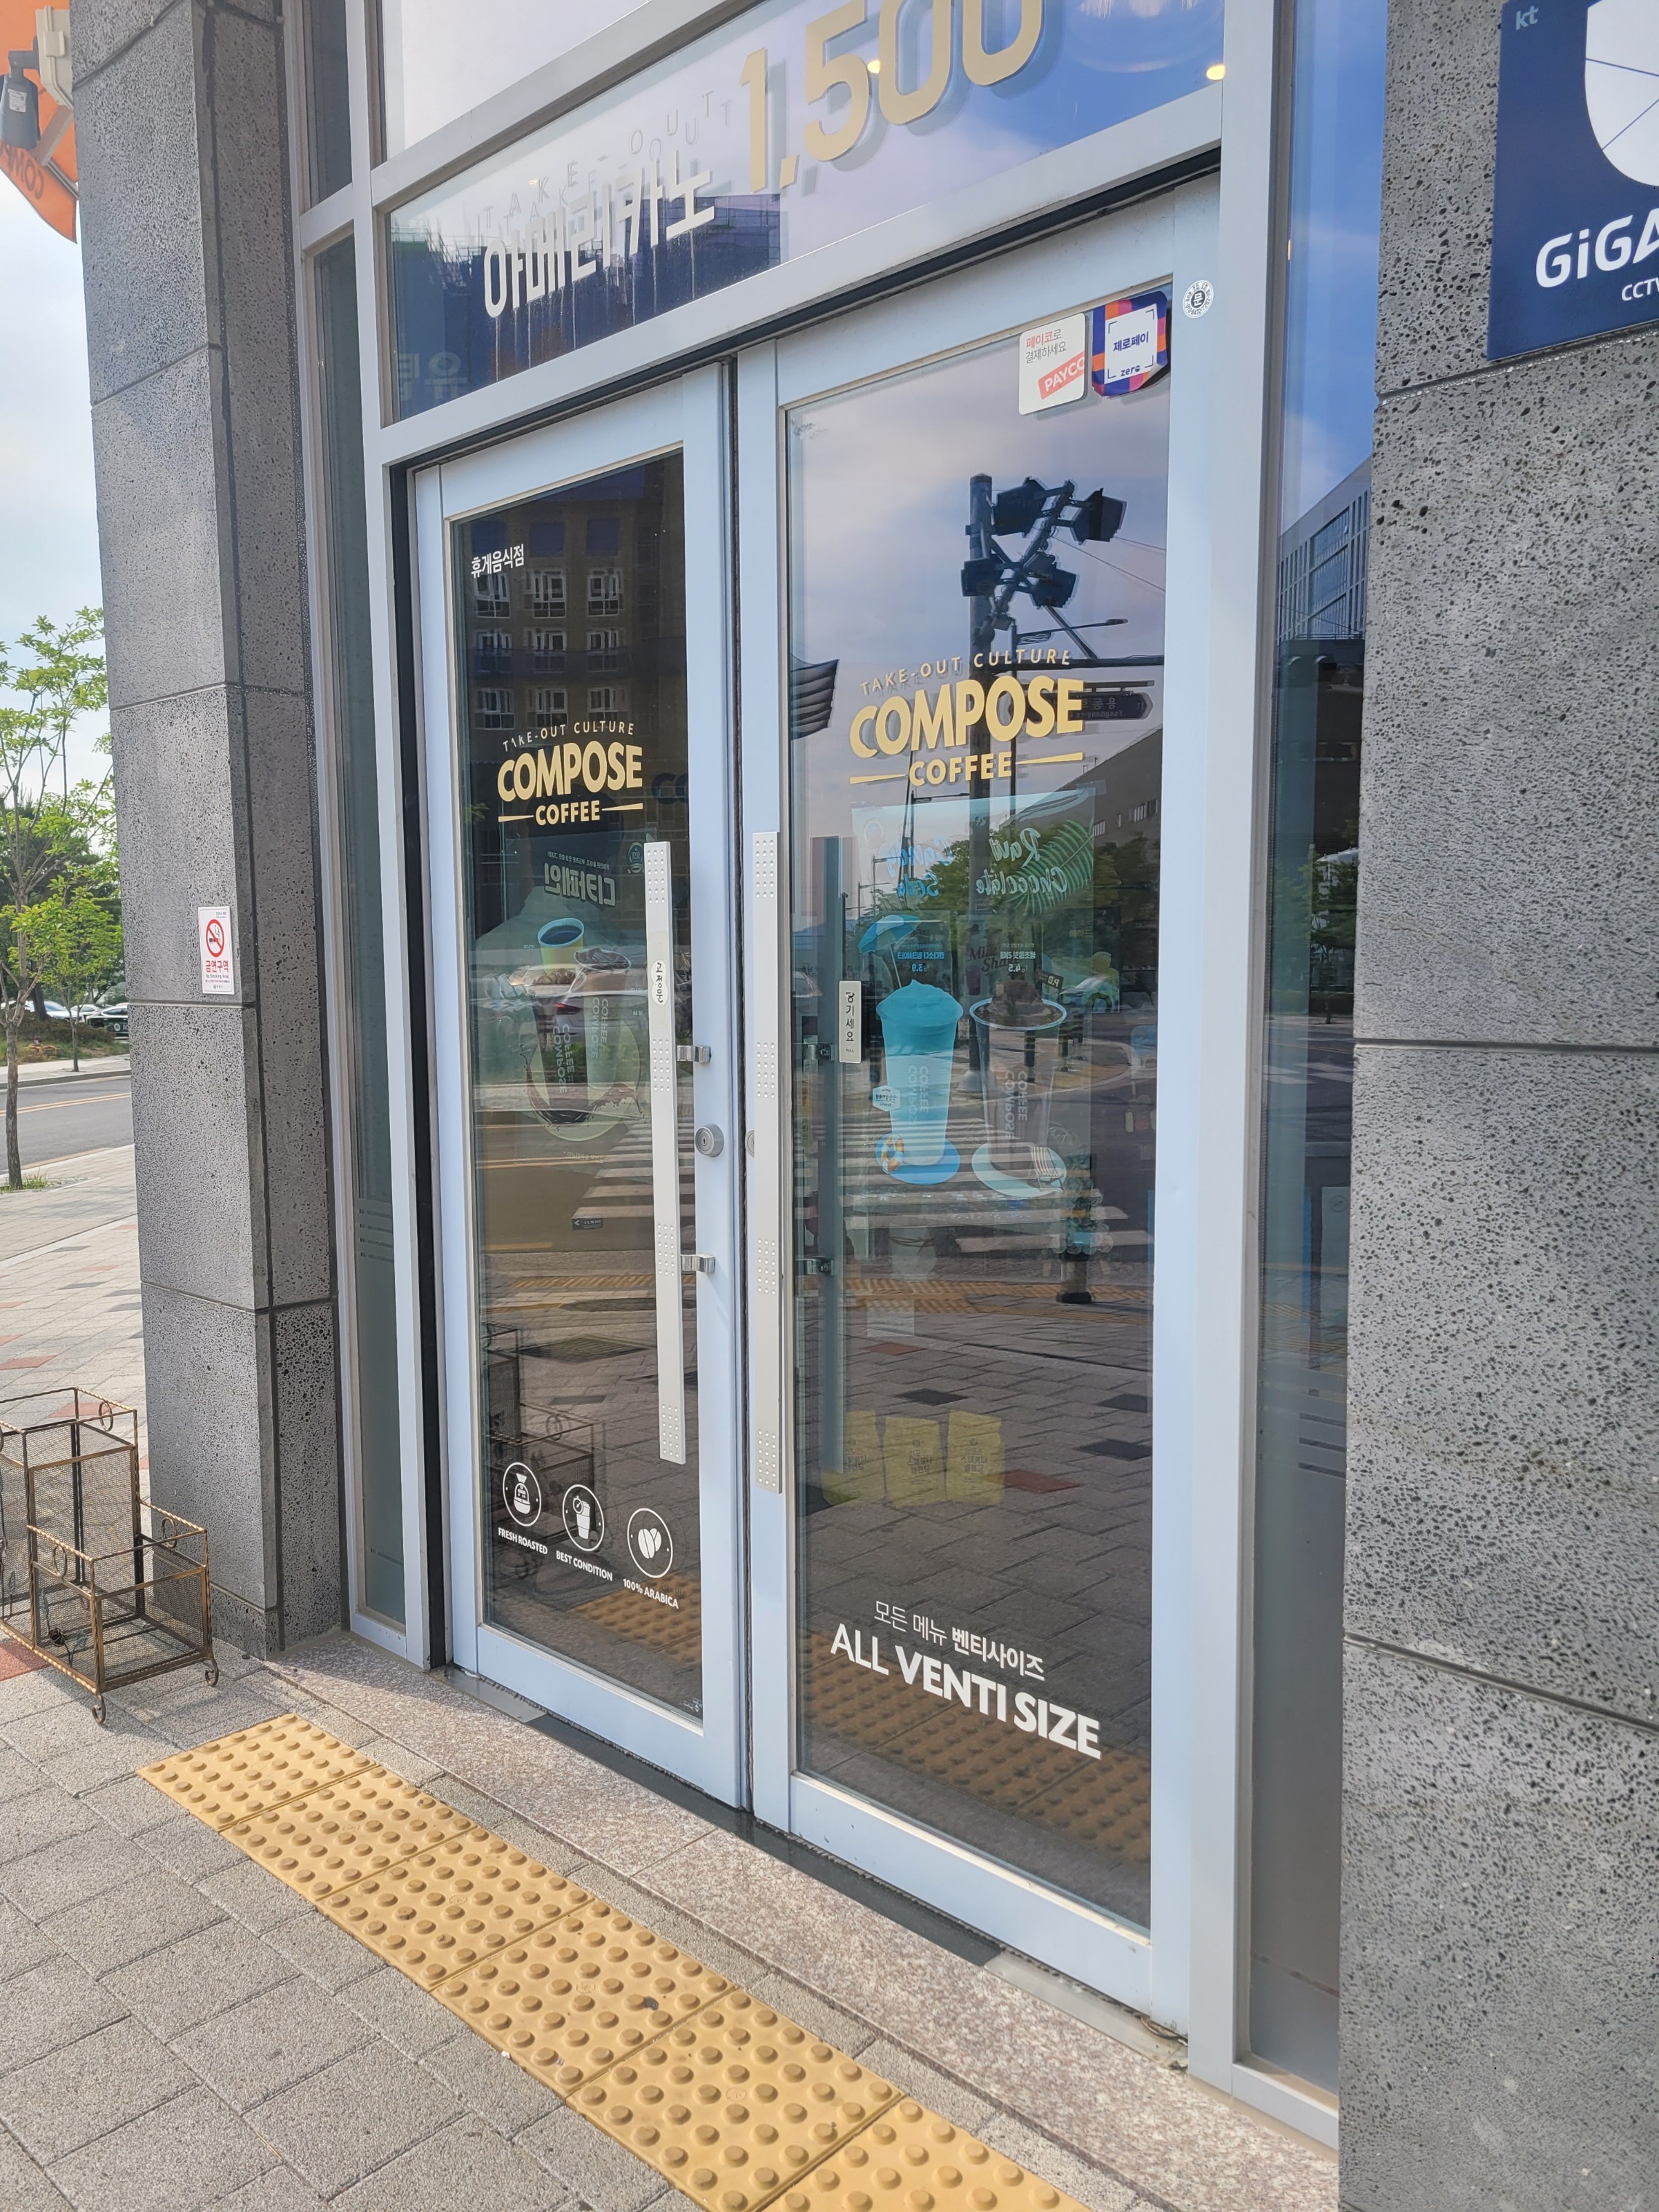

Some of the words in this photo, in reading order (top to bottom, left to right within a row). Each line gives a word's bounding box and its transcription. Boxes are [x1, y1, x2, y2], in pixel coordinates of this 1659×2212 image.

[1516, 7, 1539, 31] kt
[738, 0, 1043, 194] 1,500
[483, 150, 715, 317] 아메리카노
[1025, 341, 1067, 364] 결제하세요
[1026, 329, 1062, 349] 페이코로
[1113, 331, 1149, 351] 제로페이
[472, 544, 525, 578] 휴게음식점
[859, 656, 961, 696] TAKE-OUT
[974, 648, 1071, 667] CULTURE
[573, 720, 634, 736] CULTURE
[850, 675, 1084, 758] COMPOSE
[497, 741, 643, 802] COMPOSE
[909, 751, 1013, 787] COFFEE
[535, 800, 601, 826] COFFEE
[205, 960, 229, 973] 금연구역
[845, 992, 855, 1042] 당기세요
[498, 1527, 517, 1543] FRESH
[518, 1537, 548, 1555] ROASTED
[556, 1550, 572, 1564] BEST
[573, 1558, 613, 1581] CONDITION
[623, 1578, 643, 1594] 100%
[644, 1586, 678, 1609] ARABICA
[875, 1601, 908, 1633] 모든
[913, 1614, 947, 1647] 메뉴
[952, 1626, 1045, 1681] 벤티사이즈
[830, 1623, 889, 1676] ALL
[895, 1645, 1006, 1722] VENTI
[1014, 1692, 1101, 1760] SIZE
